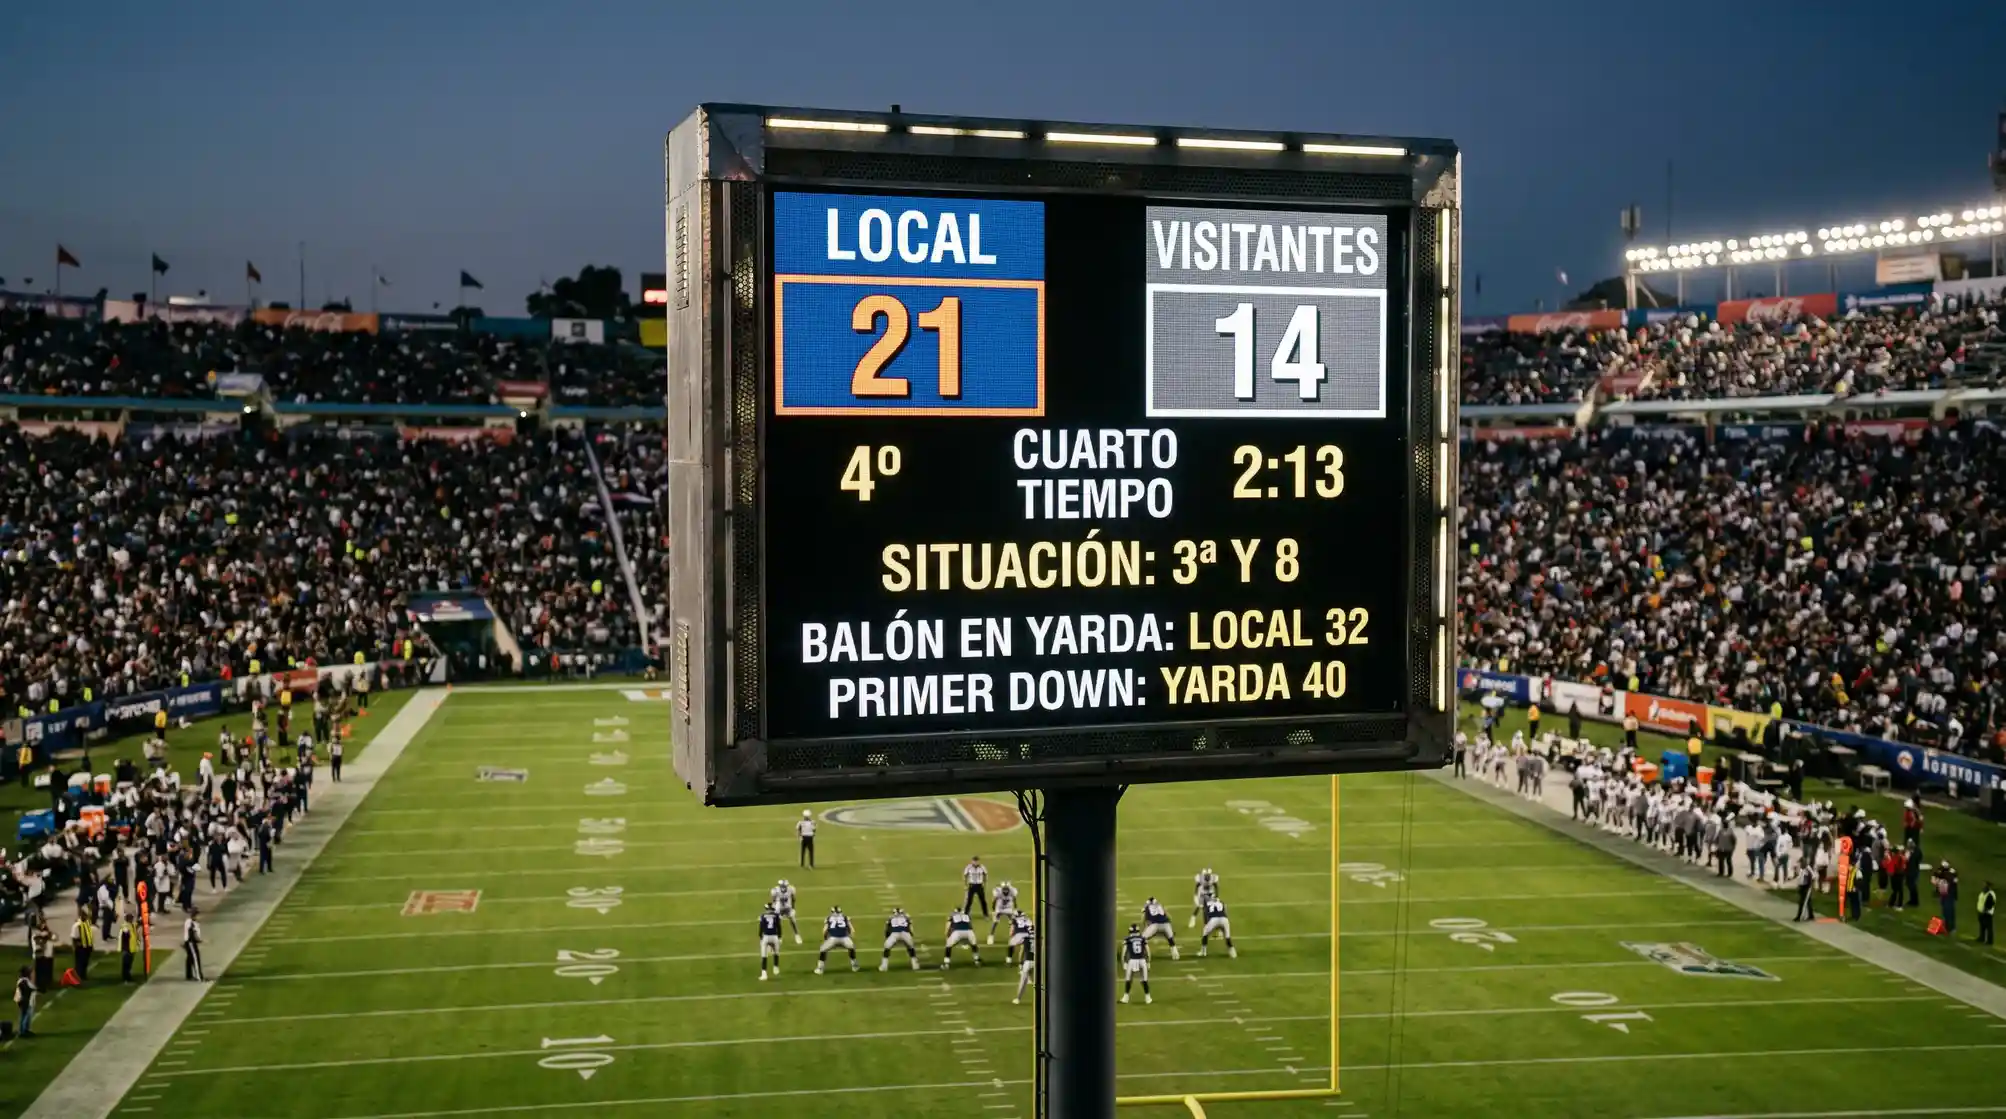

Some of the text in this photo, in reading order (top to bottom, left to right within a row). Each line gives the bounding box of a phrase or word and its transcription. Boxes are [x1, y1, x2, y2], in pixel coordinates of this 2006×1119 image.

[827, 208, 997, 265] LOCAL
[1152, 219, 1380, 276] VISITANTES
[851, 295, 962, 398] 21
[1215, 303, 1327, 400] 14
[841, 445, 901, 502] 4º
[1013, 428, 1178, 470] CUARTO
[1233, 444, 1345, 499] 2:13
[1016, 478, 1173, 520] TIEMPO
[882, 529, 1300, 592] SITUACIÓN: 3ª Y 8
[802, 607, 1369, 664] BALÓN EN YARDA: LOCAL 32
[829, 660, 1347, 719] PRIMER DOWN: YARDA 40
[566, 885, 624, 907] 30
[1131, 941, 1142, 954] 6
[1429, 918, 1517, 943] 20
[554, 949, 620, 977] 20
[1550, 992, 1653, 1023] 10
[537, 1034, 616, 1069] 10
